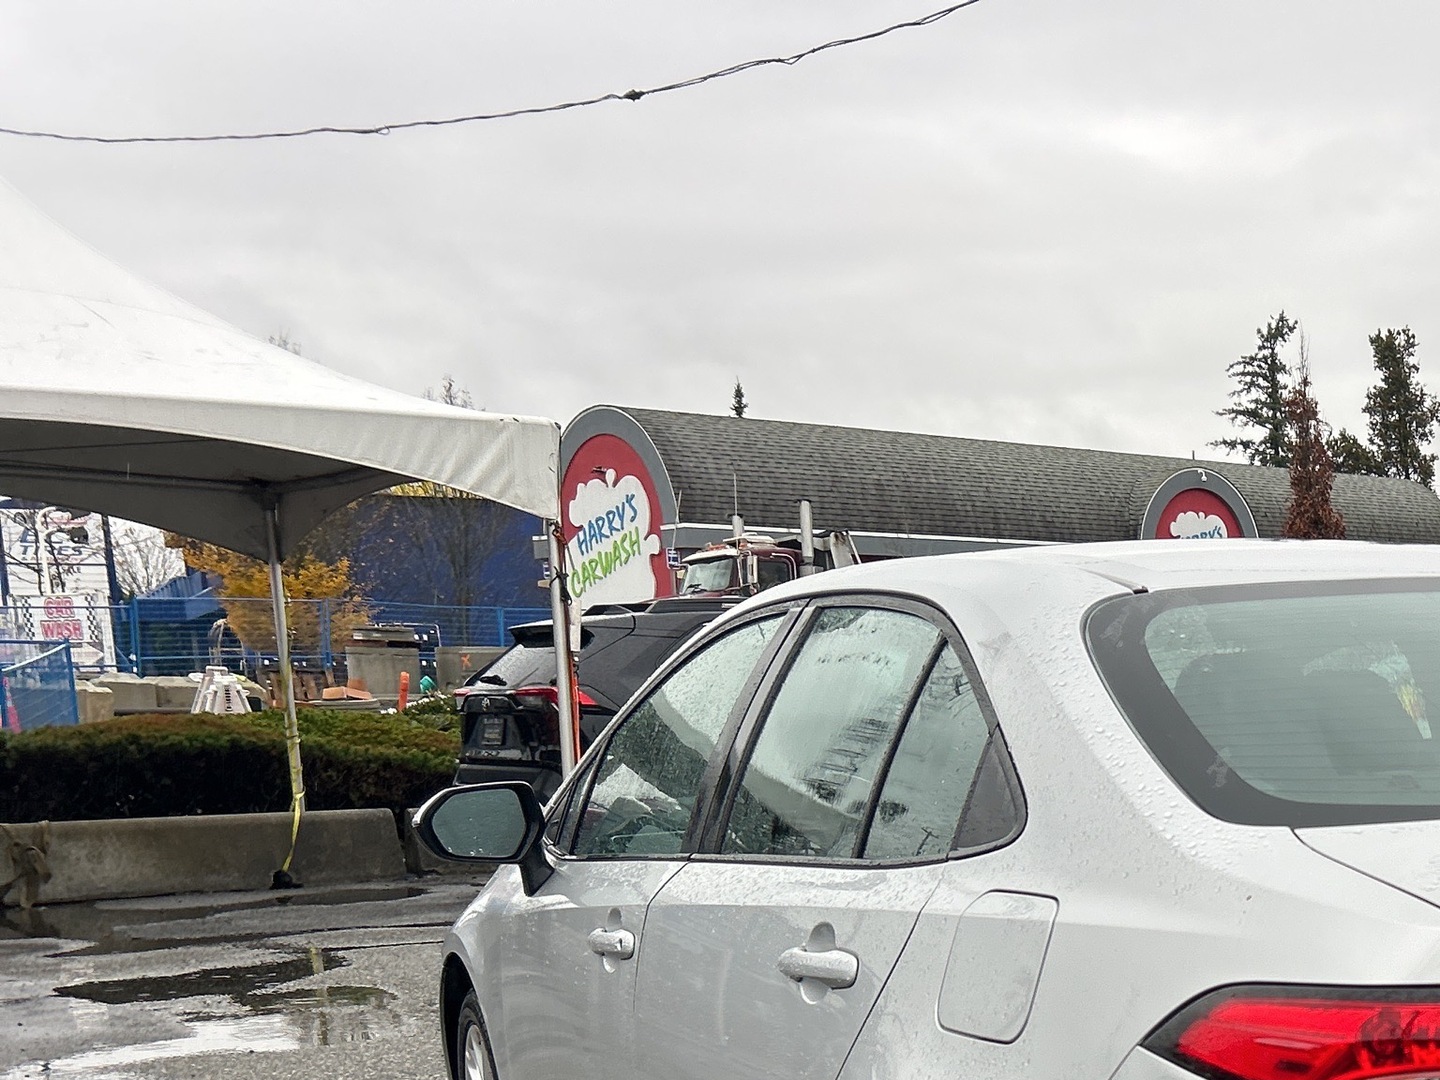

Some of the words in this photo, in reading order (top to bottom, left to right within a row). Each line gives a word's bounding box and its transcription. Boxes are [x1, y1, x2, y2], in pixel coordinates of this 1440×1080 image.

[576, 493, 638, 556] HARRY'S
[570, 526, 642, 598] CARWASH
[44, 596, 76, 618] CAR
[40, 619, 84, 640] WASH
